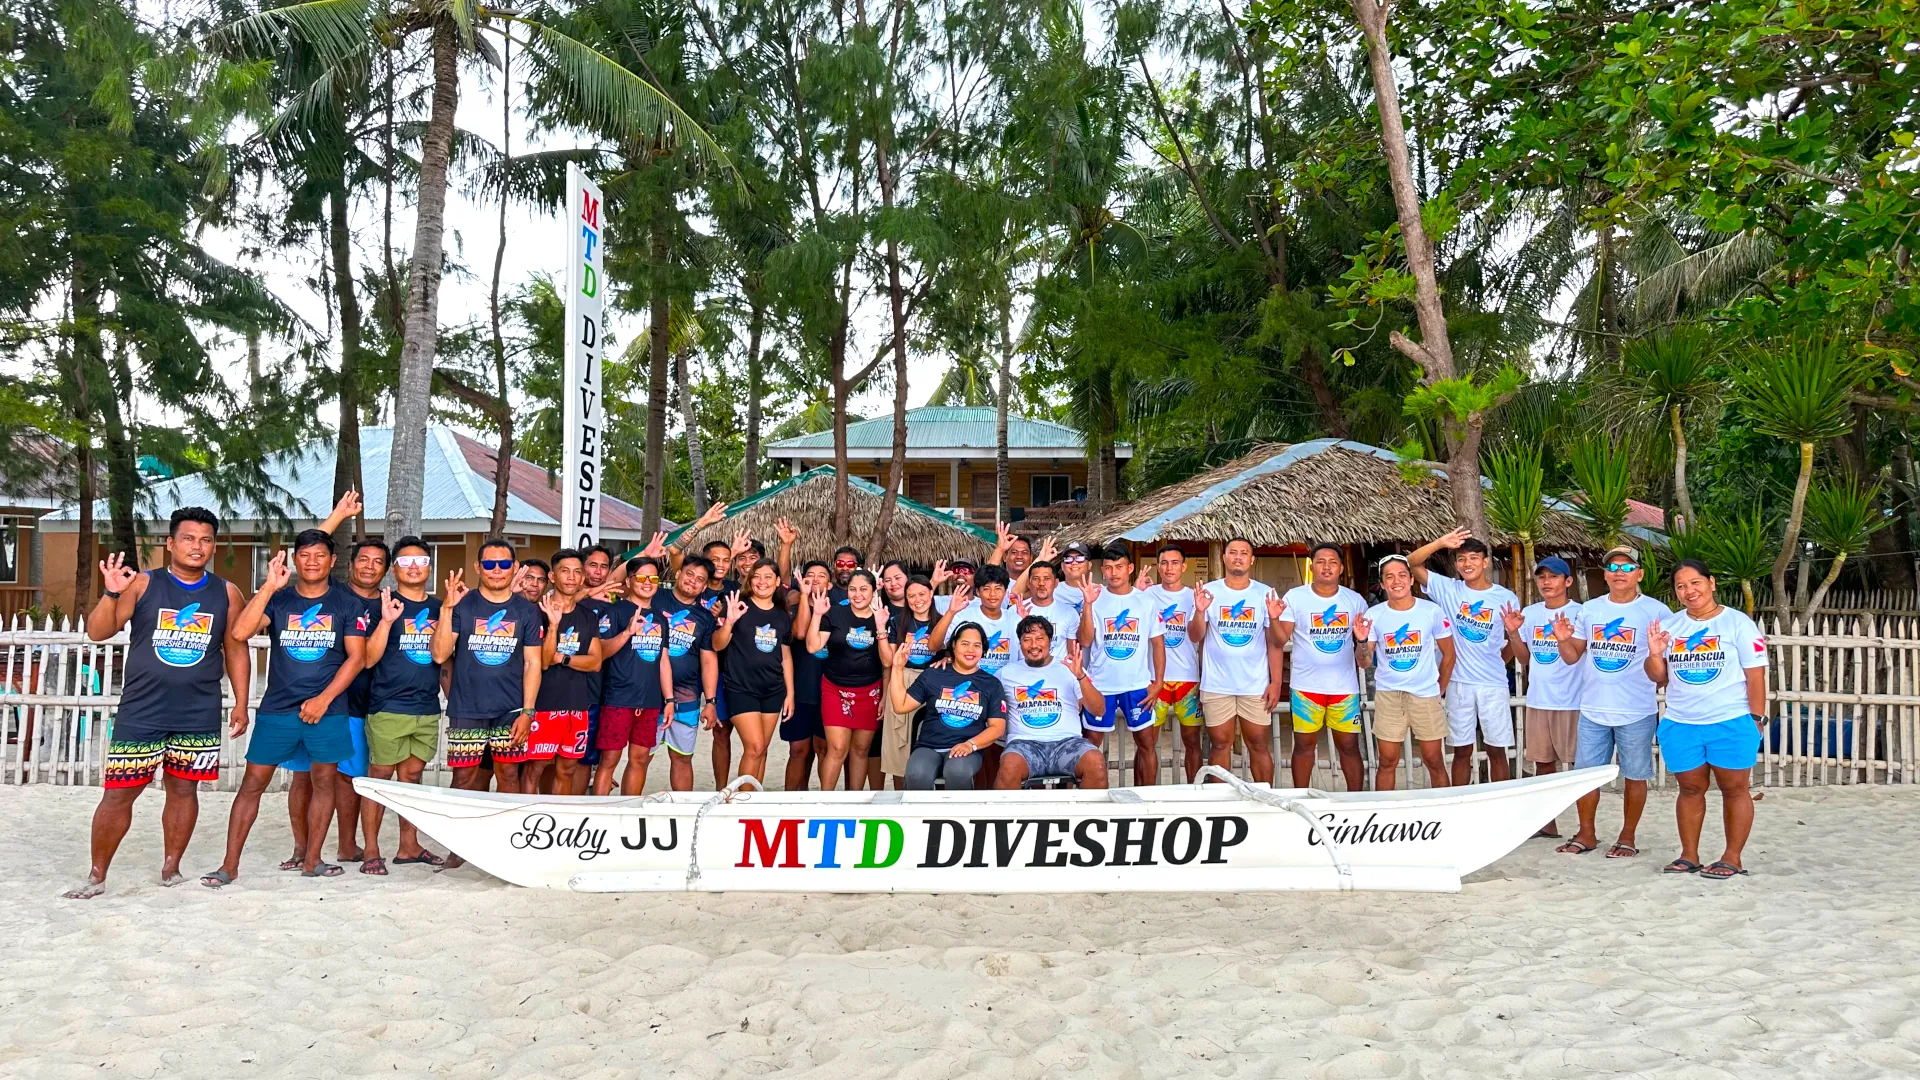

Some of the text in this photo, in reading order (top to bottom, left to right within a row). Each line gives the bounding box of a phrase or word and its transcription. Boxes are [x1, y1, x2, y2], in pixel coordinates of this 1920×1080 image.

[577, 187, 599, 550] MTD DIVESHO
[1217, 620, 1258, 630] MALAPASCUA
[152, 629, 213, 645] MALAPASCUA
[279, 629, 337, 642] MALAPASCUA
[399, 634, 432, 644] MALAPAS
[152, 639, 187, 649] THRESHER
[279, 640, 335, 649] THRESHER DIVERS
[467, 643, 497, 652] THRESHER
[1589, 641, 1637, 653] MALAPASCUA
[1668, 651, 1725, 663] MALAPASCUA
[1701, 661, 1725, 669] DIVERS
[935, 699, 983, 715] MALAPASCUA
[192, 750, 219, 770] 07
[510, 813, 678, 861] Baby JJ
[734, 815, 1249, 869] MTD DIVESHOP
